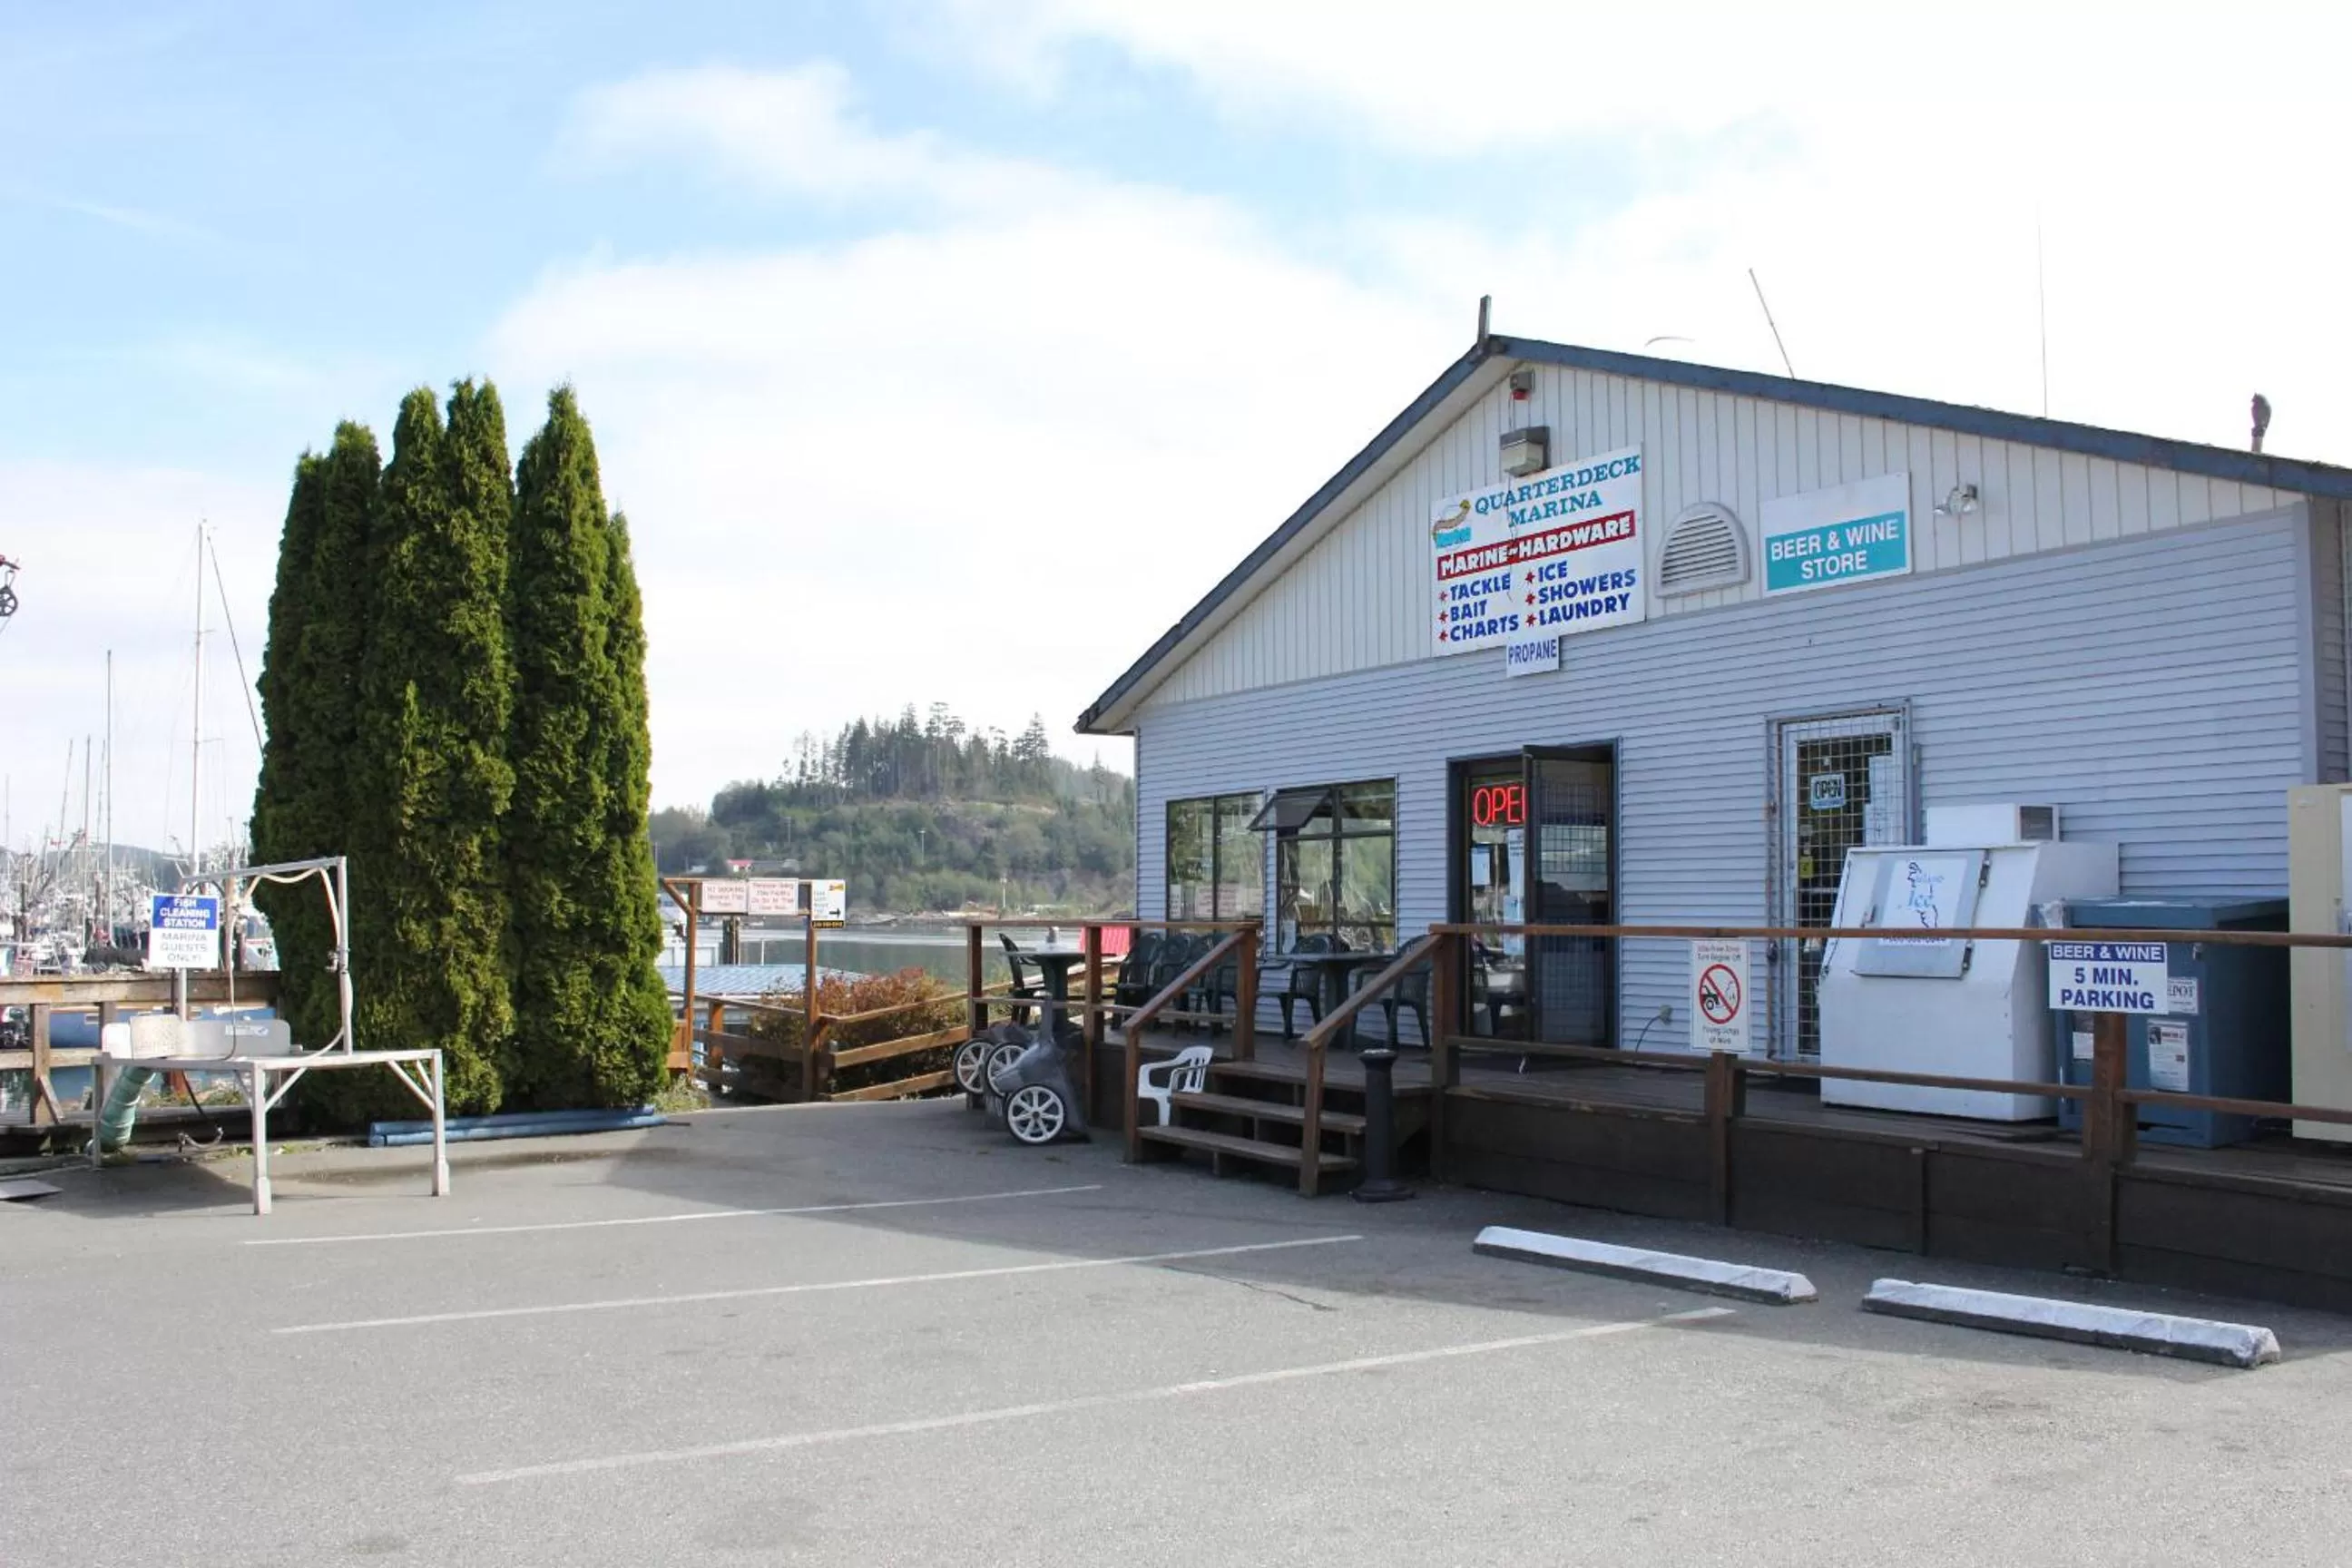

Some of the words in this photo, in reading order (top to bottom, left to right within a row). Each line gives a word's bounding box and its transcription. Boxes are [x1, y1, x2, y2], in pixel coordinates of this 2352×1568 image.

[1475, 455, 1641, 514] QUARTERDECK
[1508, 490, 1602, 527] MARINA
[1771, 534, 1821, 562] BEER
[1828, 530, 1841, 551] &
[1846, 518, 1899, 546] WINE
[1538, 560, 1568, 583] ICE
[1801, 550, 1867, 579] STORE
[1450, 573, 1512, 602] TACKLE
[1538, 569, 1637, 605] SHOWERS
[1450, 599, 1488, 622] BAIT
[1539, 593, 1632, 626] LAUNDRY
[1450, 613, 1519, 642] CHARTS
[1507, 638, 1558, 665] PROPANE
[1815, 779, 1842, 799] OPEN
[1474, 785, 1526, 827] OPE
[159, 906, 211, 919] CLEANING
[173, 897, 197, 907] FISH
[163, 917, 207, 929] STATION
[160, 942, 209, 953] GUESTS
[162, 932, 208, 942] MARINA
[2053, 944, 2094, 959] BEER
[2099, 945, 2112, 959] &
[2115, 945, 2163, 961] WINE
[2074, 966, 2085, 985] 5
[2092, 967, 2140, 986] MIN.
[2061, 988, 2154, 1010] PARKING
